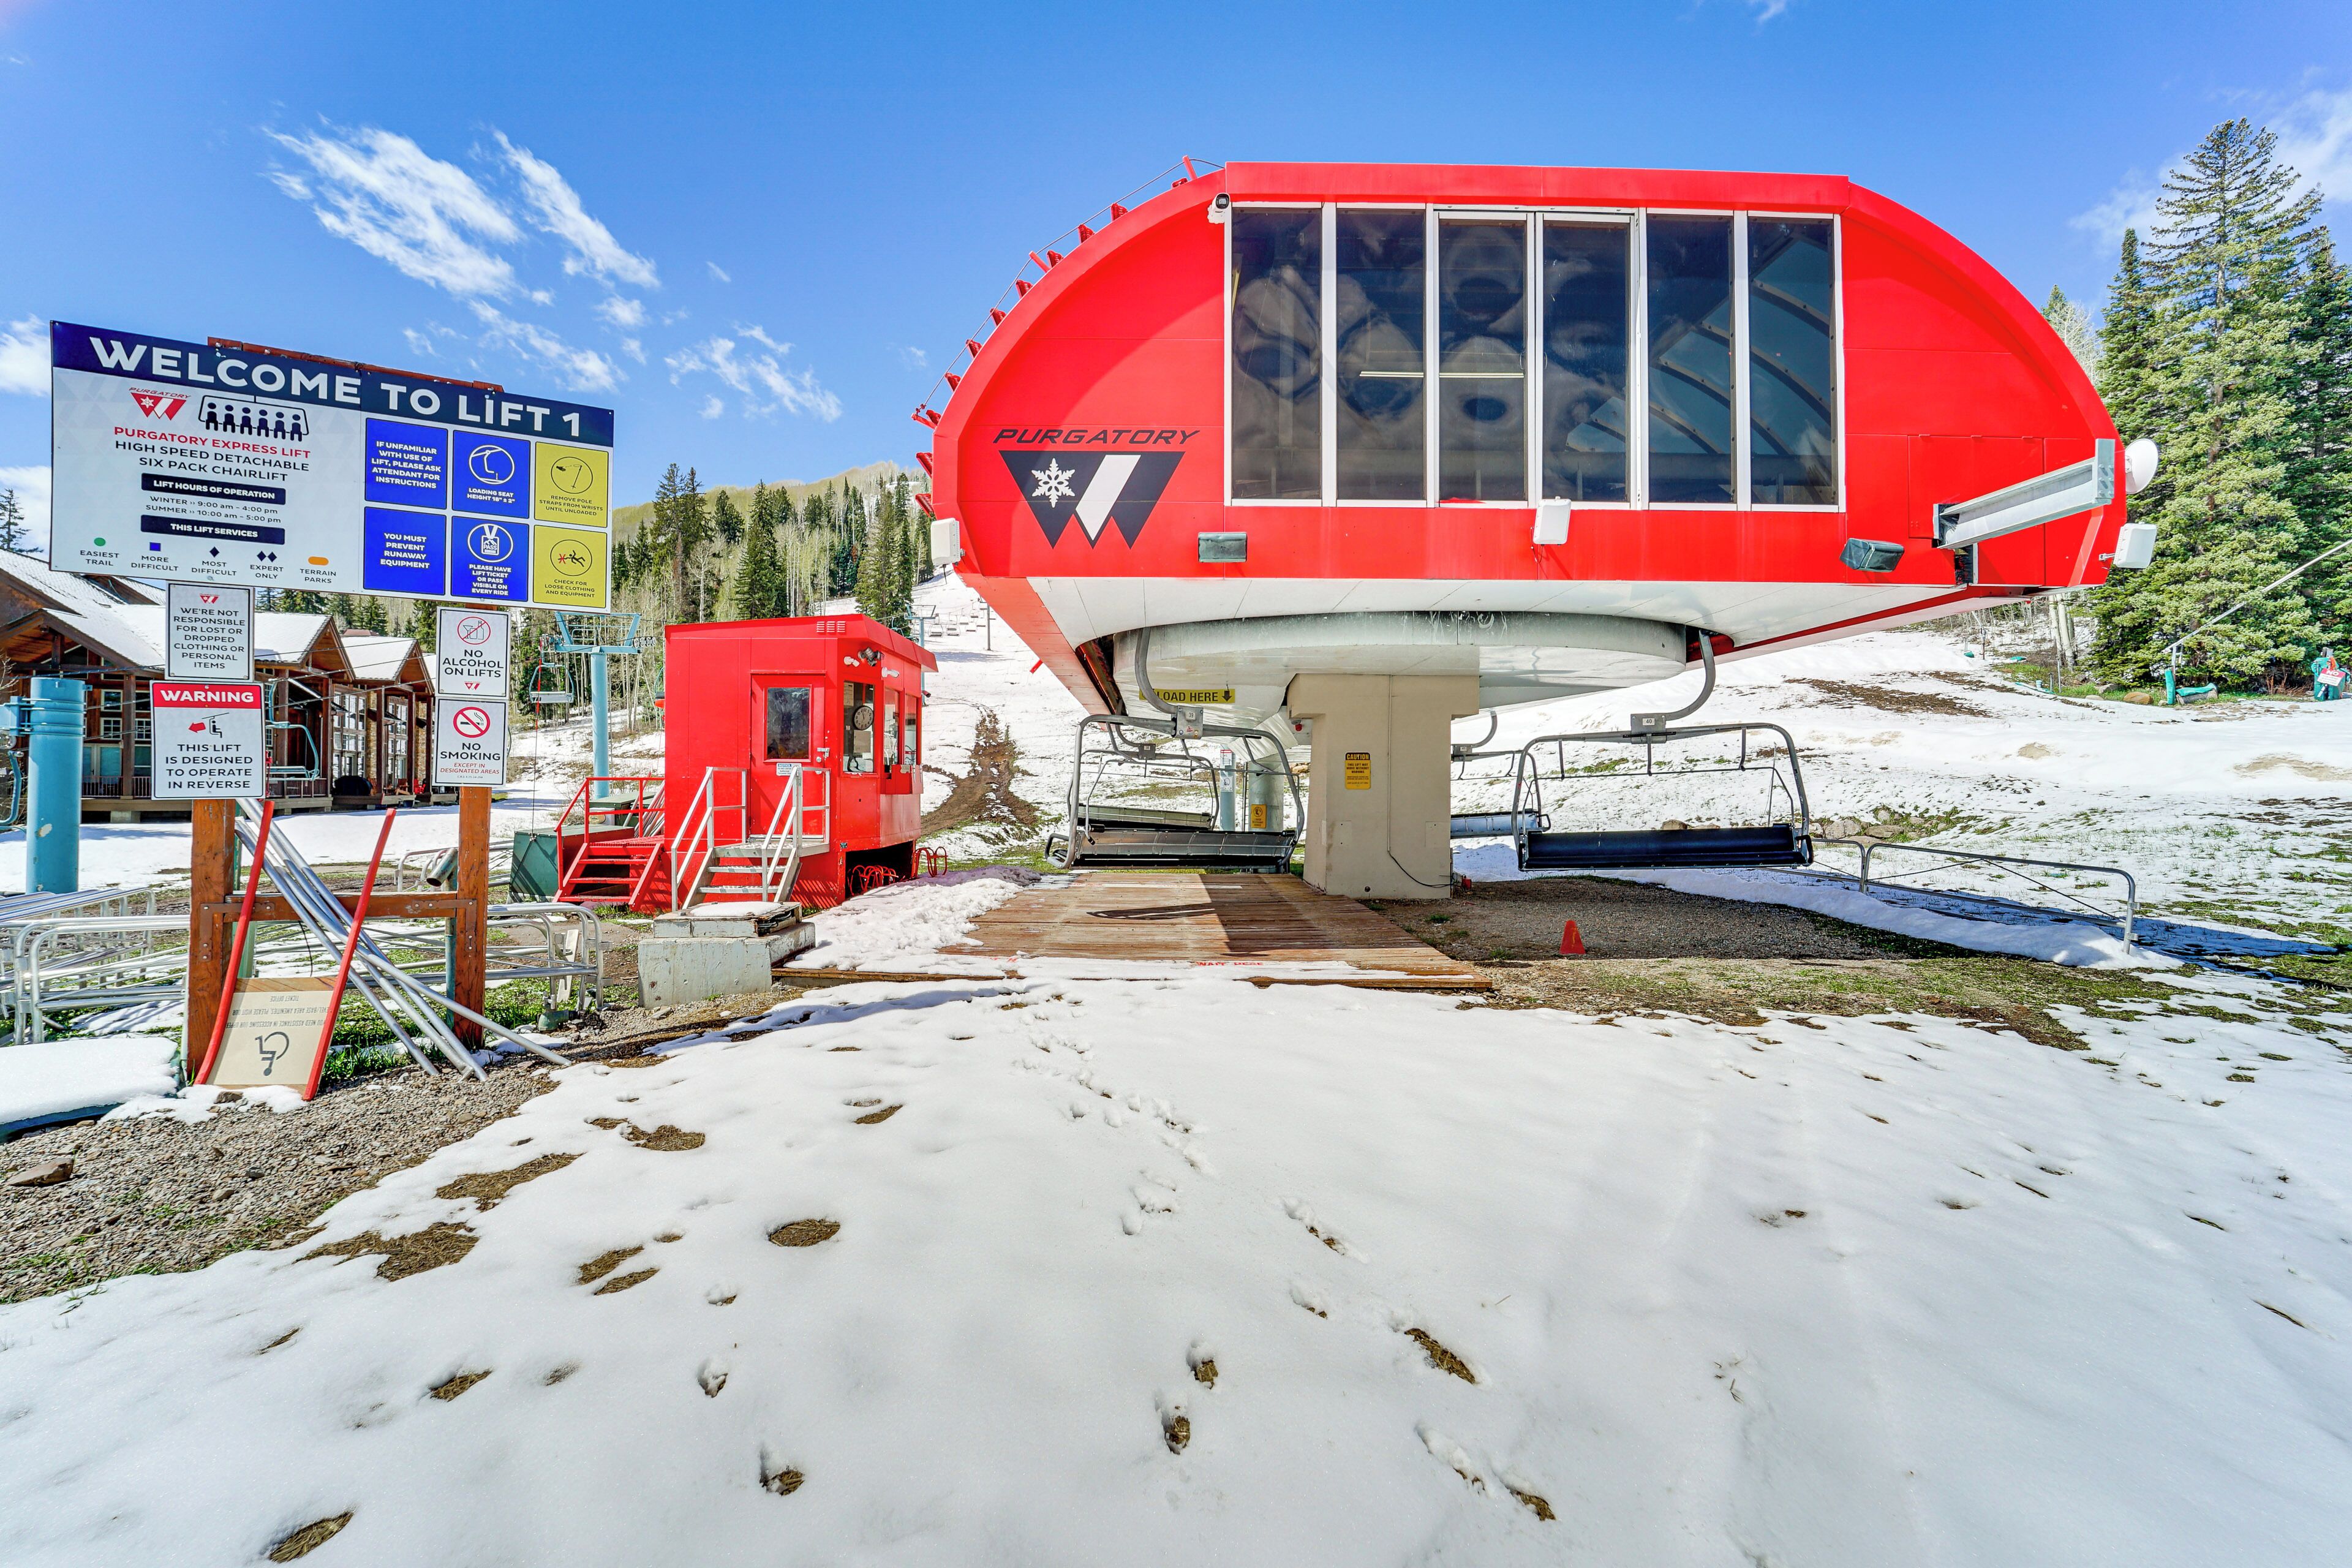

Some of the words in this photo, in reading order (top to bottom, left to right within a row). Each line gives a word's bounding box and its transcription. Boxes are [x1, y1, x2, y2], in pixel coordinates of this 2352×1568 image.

[89, 336, 361, 405] WELCOME
[380, 382, 440, 415] TO
[458, 394, 550, 431] LIFT
[562, 412, 579, 437] 1
[129, 387, 191, 399] PURGATORY
[993, 428, 1200, 445] PURGATORY
[115, 426, 207, 446] PURGATORY
[212, 439, 277, 455] EXPRESS
[282, 448, 310, 459] LIFT
[386, 442, 437, 454] UNFAMILIAR
[116, 441, 155, 454] HIGH
[160, 447, 209, 461] SPEED
[214, 452, 309, 472] DETACHABLE
[379, 450, 401, 459] WITH
[371, 458, 390, 467] LIFT,
[392, 460, 423, 470] PLEASE
[139, 458, 162, 467] SIX
[168, 461, 208, 473] PACK
[212, 465, 288, 481] CHAIRLIFT
[372, 467, 421, 479] ATTENDANT
[376, 476, 436, 489] INSTRUCTIONS
[154, 480, 173, 489] LIFT
[176, 481, 206, 492] HOURS
[225, 486, 275, 499] OPERATION
[469, 488, 496, 496] LOADING
[150, 496, 187, 505] WINTER
[146, 505, 187, 513] SUMMER
[170, 523, 192, 532] THIS
[214, 527, 258, 538] SERVICES
[386, 542, 424, 551] PREVENT
[80, 550, 119, 559] EASIEST
[141, 555, 169, 564] MORE
[384, 551, 426, 560] RUNAWAY
[131, 562, 179, 572] DIFFICULT
[202, 559, 227, 568] MOST
[250, 564, 284, 573] EXPERT
[380, 559, 429, 569] EQUIPMENT
[191, 566, 236, 576] DIFFICULT
[300, 568, 336, 577] TERRAIN
[181, 607, 214, 616] WE'RE
[173, 616, 245, 626] RESPONSIBLE
[184, 635, 235, 643] DROPPED
[174, 643, 227, 652] CLOTHING
[182, 652, 238, 662] PERSONAL
[464, 649, 483, 658] NO
[442, 657, 503, 669] ALCOHOL
[445, 668, 465, 676] ON
[468, 669, 501, 678] LIFTS
[160, 690, 254, 703] WARNING
[1190, 692, 1218, 701] HERE
[462, 742, 481, 751] NO
[165, 756, 179, 764] IS
[183, 756, 252, 764] DESIGNED
[440, 751, 501, 761] SMOKING
[189, 768, 252, 777] OPERATE
[186, 780, 250, 789] REVERSE
